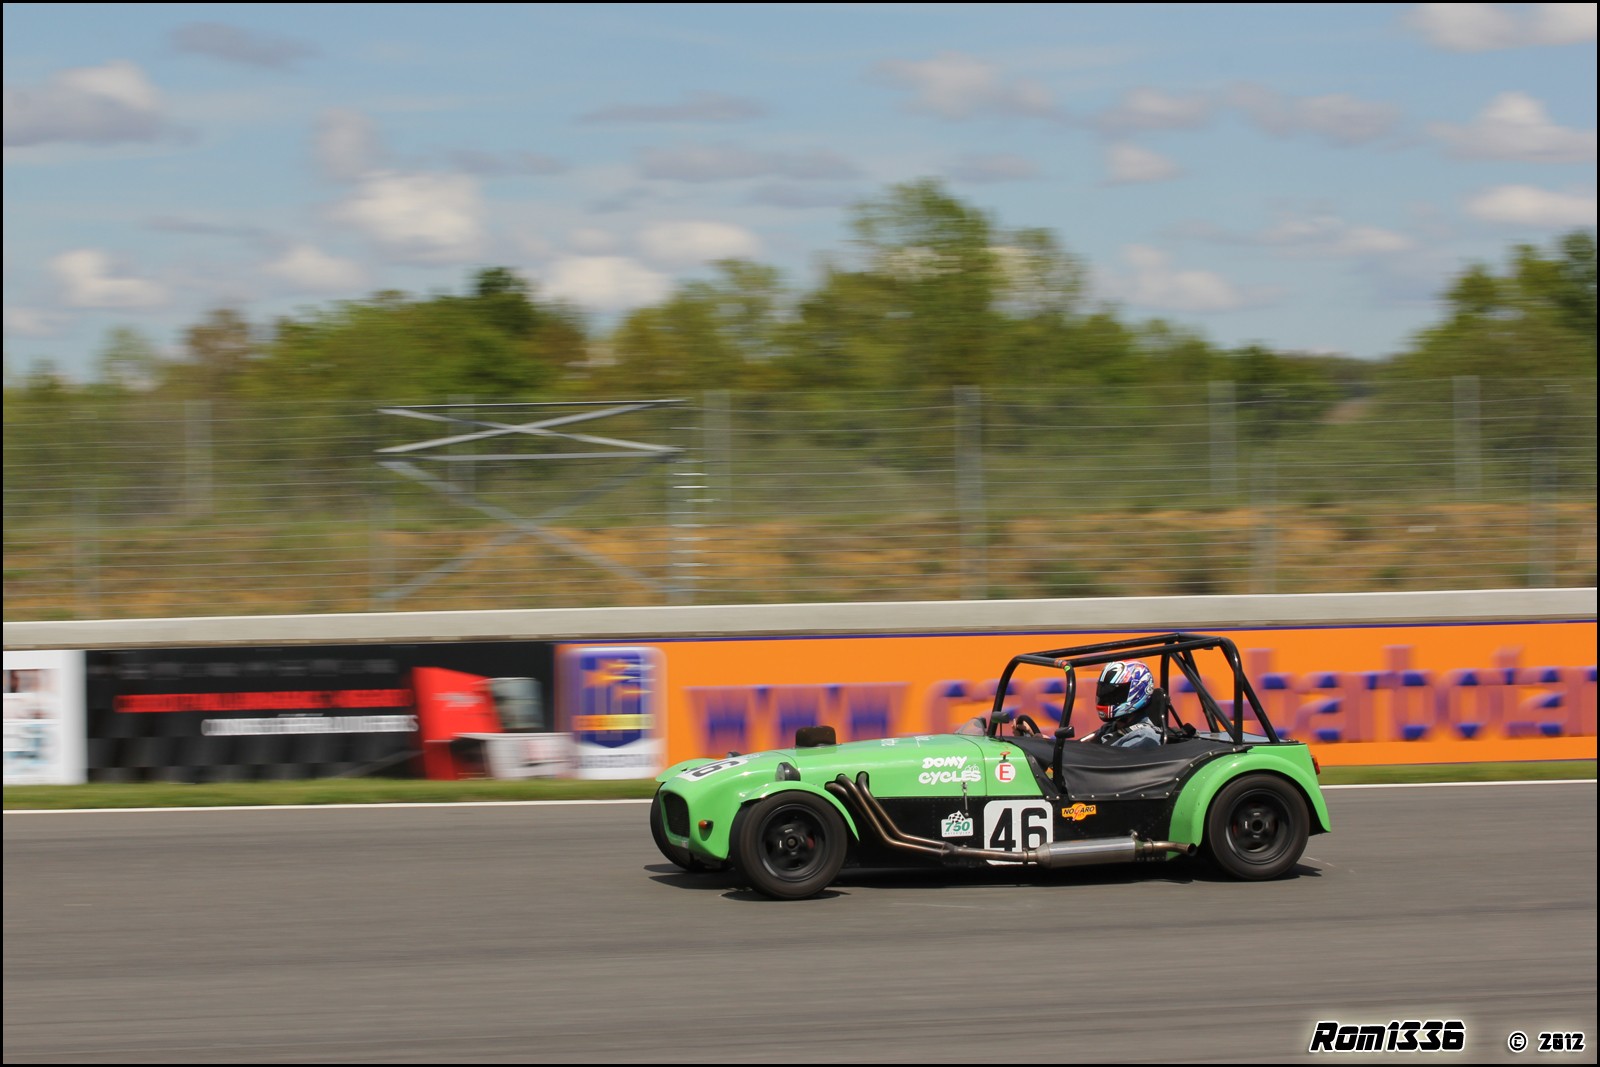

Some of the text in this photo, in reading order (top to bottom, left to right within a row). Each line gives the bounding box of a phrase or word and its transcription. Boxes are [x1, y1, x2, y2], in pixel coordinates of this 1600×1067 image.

[922, 756, 967, 769] DOMY
[918, 770, 982, 785] CYCLES
[999, 764, 1012, 781] E
[945, 821, 970, 832] 750
[989, 807, 1048, 853] 46
